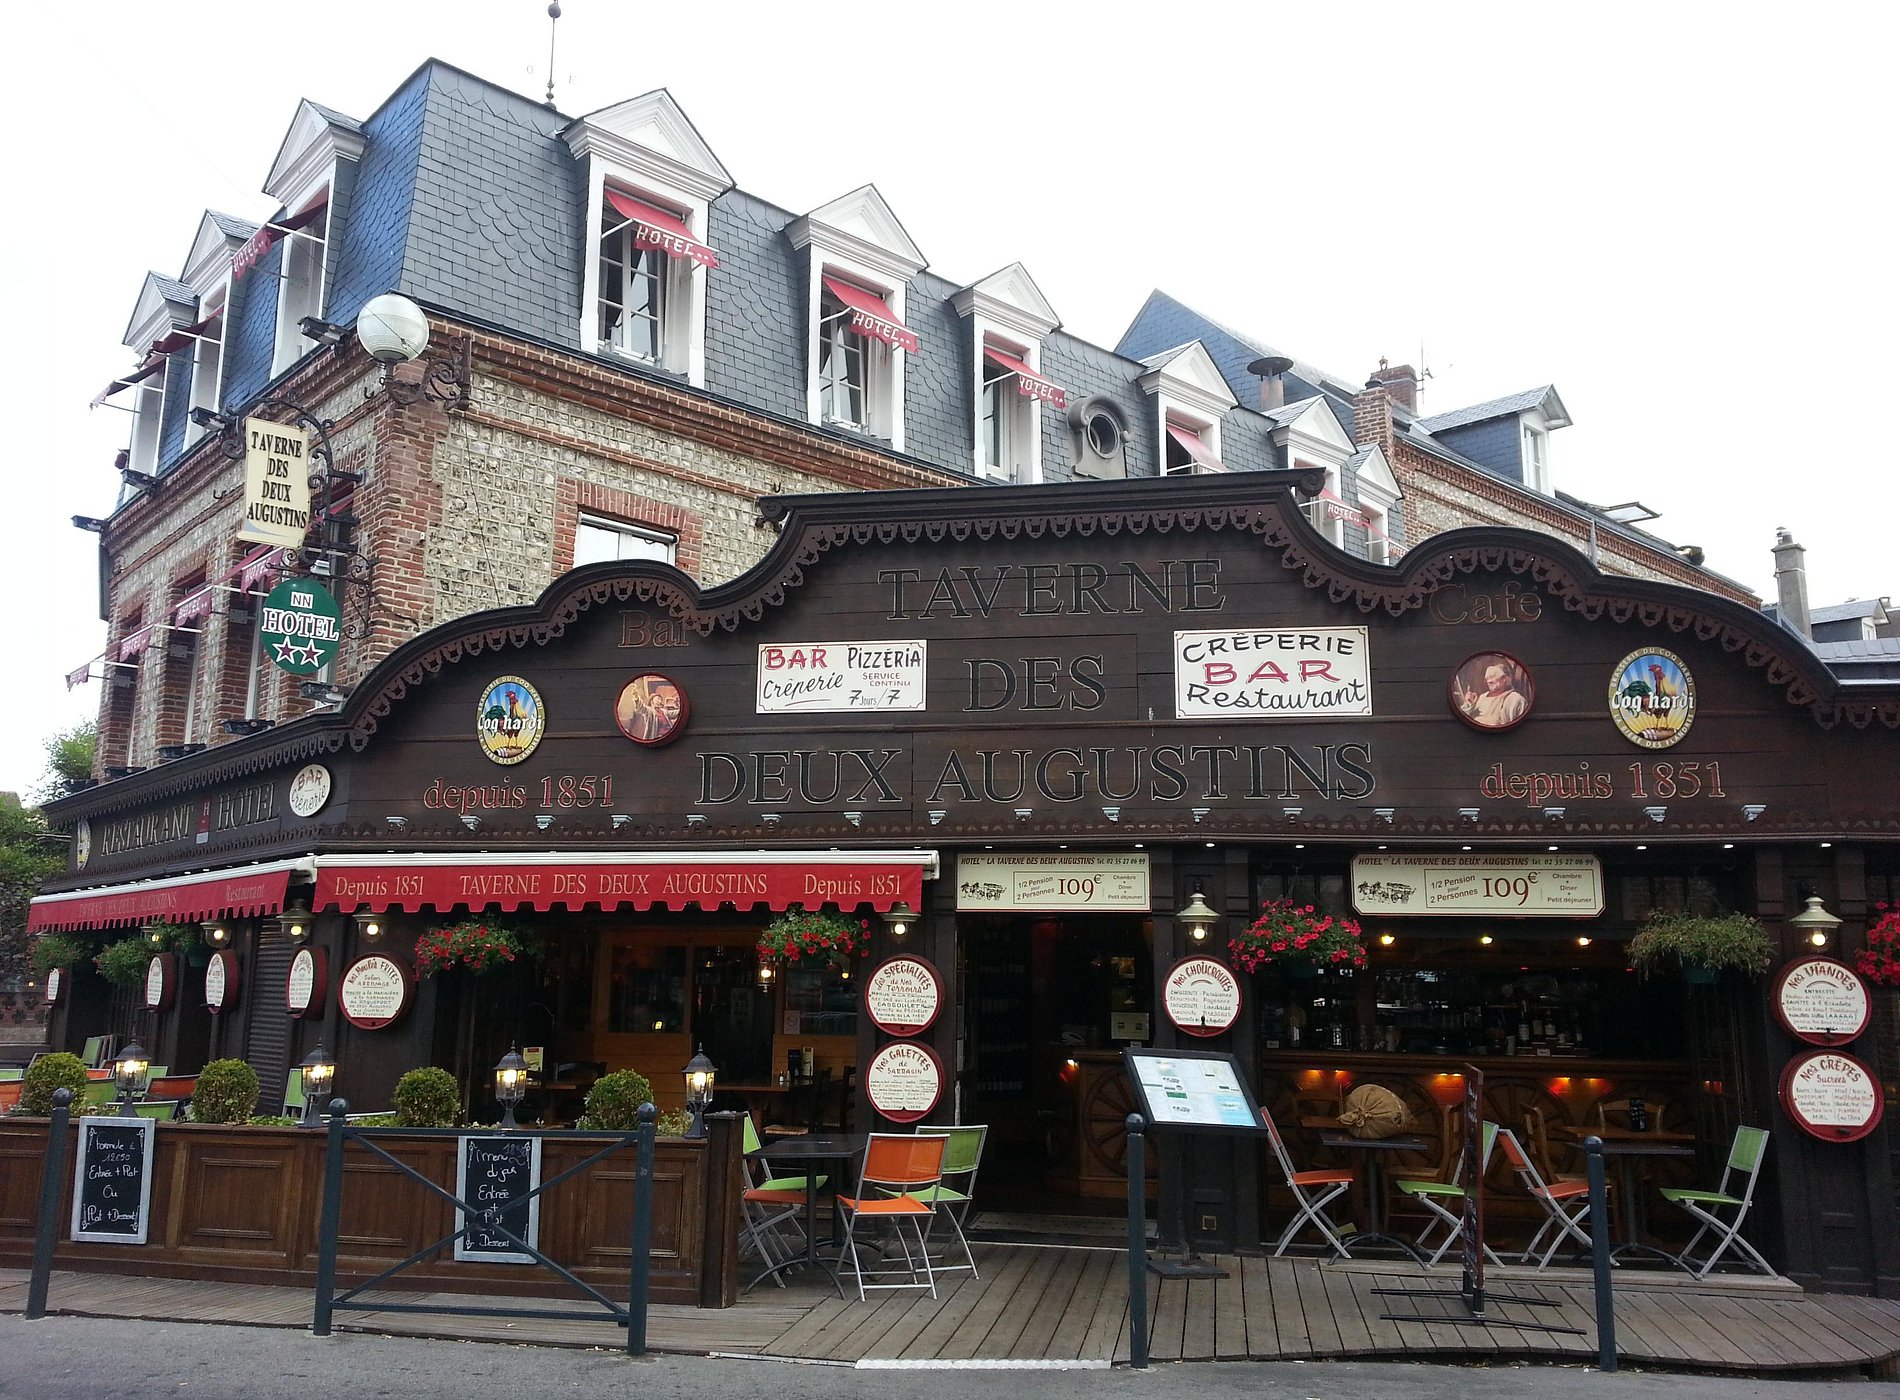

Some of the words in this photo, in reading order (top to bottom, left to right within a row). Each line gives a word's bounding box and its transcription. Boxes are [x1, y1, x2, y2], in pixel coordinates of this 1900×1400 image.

[636, 225, 694, 256] HOTEL
[232, 239, 258, 272] HOTEL
[853, 311, 899, 341] HOTEL
[251, 431, 302, 458] TAVERNE
[267, 457, 289, 479] DES
[261, 479, 292, 503] DEUX
[246, 502, 308, 530] AUGUSTINS
[1327, 502, 1355, 522] HOTEL
[291, 592, 312, 608] NN
[877, 559, 1226, 620] TAVERNE
[261, 608, 340, 641] HOTEL
[618, 610, 690, 648] Bar
[1182, 630, 1356, 663] CRÊPERIE
[764, 648, 829, 671] BAR
[963, 653, 1107, 713] DES
[1204, 659, 1341, 686] BAR
[763, 670, 844, 701] Crêperie
[1186, 678, 1367, 711] Restaurant
[1611, 690, 1642, 712] Coq
[1647, 690, 1694, 709] hardi
[478, 715, 499, 733] Coq
[502, 714, 542, 730] hardi
[298, 767, 323, 792] BAR
[694, 749, 903, 805] DEUX
[926, 743, 1376, 804] AUGUSTINS
[1480, 761, 1613, 808] depuis
[1629, 760, 1726, 799] 1851
[423, 776, 527, 816] depuis
[538, 775, 614, 808] 1851
[101, 803, 194, 857] RESTAURANT
[216, 780, 281, 833] HOTEL
[960, 857, 981, 865] HOTEL
[986, 857, 995, 865] LA
[997, 857, 1025, 865] TAVERNE
[1026, 857, 1039, 865] DES
[1040, 857, 1057, 865] DEUX
[1058, 857, 1095, 865] AUGUSTINS
[1358, 857, 1383, 866] HOTEL
[1390, 857, 1400, 866] LA
[1403, 857, 1439, 866] TAVERNE
[1441, 857, 1456, 866] DES
[1458, 857, 1480, 866] DEUX
[1482, 857, 1529, 866] AUGUSTINS
[335, 875, 388, 901] Depuis
[393, 875, 425, 896] 1851
[459, 874, 541, 895] TAVERNE
[552, 874, 587, 895] DES
[599, 874, 650, 895] DEUX
[662, 873, 768, 895] AUGUSTINS
[803, 873, 862, 900] Depuis
[868, 874, 901, 896] 1851
[1018, 880, 1027, 889] 1/2
[1028, 875, 1054, 887] Pension
[1431, 879, 1443, 889] 1/2
[1444, 875, 1476, 887] Pension
[1552, 872, 1582, 880] Chambre
[225, 883, 265, 904] Restaurant
[1022, 886, 1055, 900] Personnes
[1437, 888, 1479, 902] Personnes
[380, 961, 400, 985] FRITES
[884, 963, 932, 991] SPÉCIALITÉS
[1172, 973, 1187, 989] Nos
[1185, 963, 1233, 992] CHOUCROUTES
[1787, 973, 1805, 989] Nos
[875, 1057, 889, 1073] Nos
[888, 1048, 931, 1072] GALETTES
[1800, 1064, 1819, 1082] Nos
[1819, 1058, 1862, 1083] CRÊPES
[88, 1164, 113, 1180] Entrée
[122, 1164, 139, 1177] Plat
[477, 1184, 511, 1201] Entrée
[86, 1204, 103, 1222] Plat
[483, 1208, 504, 1225] Pat
